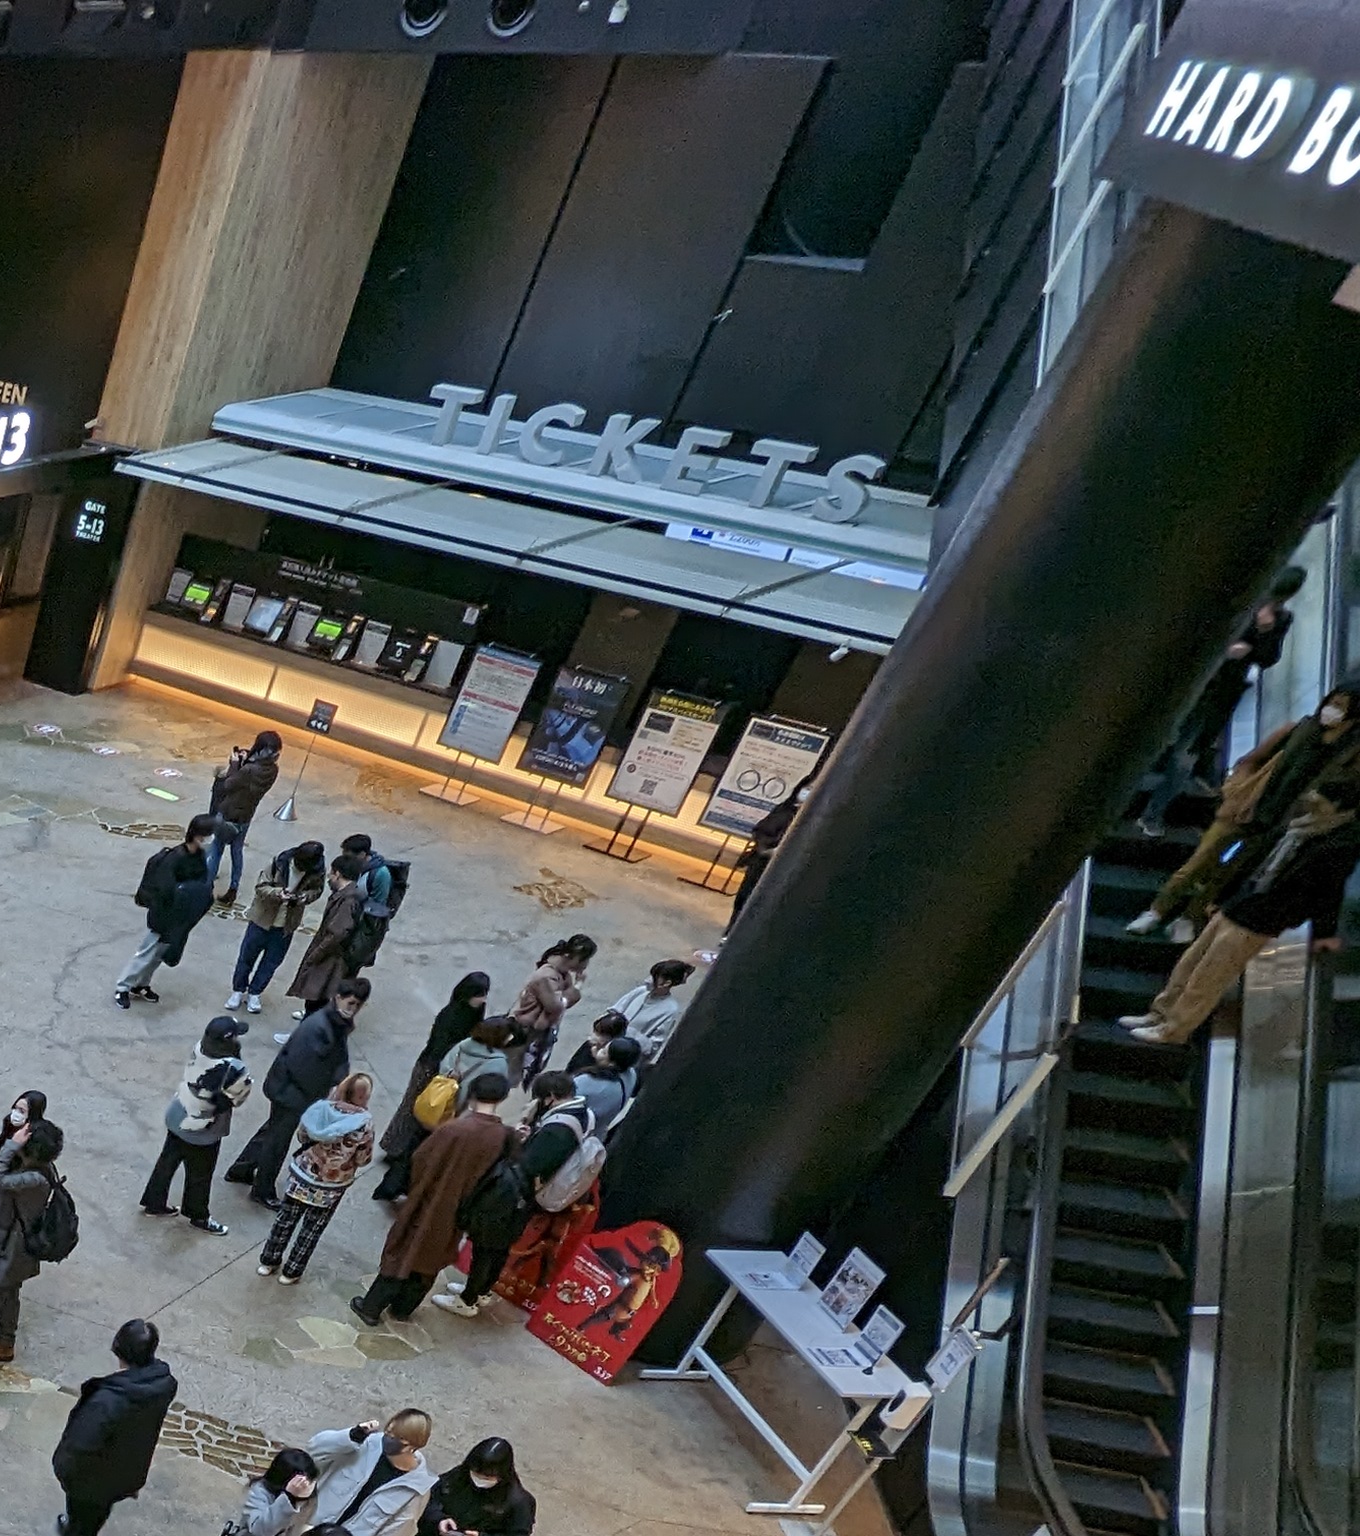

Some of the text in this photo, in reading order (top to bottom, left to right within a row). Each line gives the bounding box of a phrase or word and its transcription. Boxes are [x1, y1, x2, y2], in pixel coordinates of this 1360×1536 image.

[1144, 61, 1292, 159] HARD
[429, 382, 887, 525] TICKETS
[85, 501, 106, 514] GATE
[76, 514, 105, 536] 5-13
[572, 675, 608, 696] 日本初
